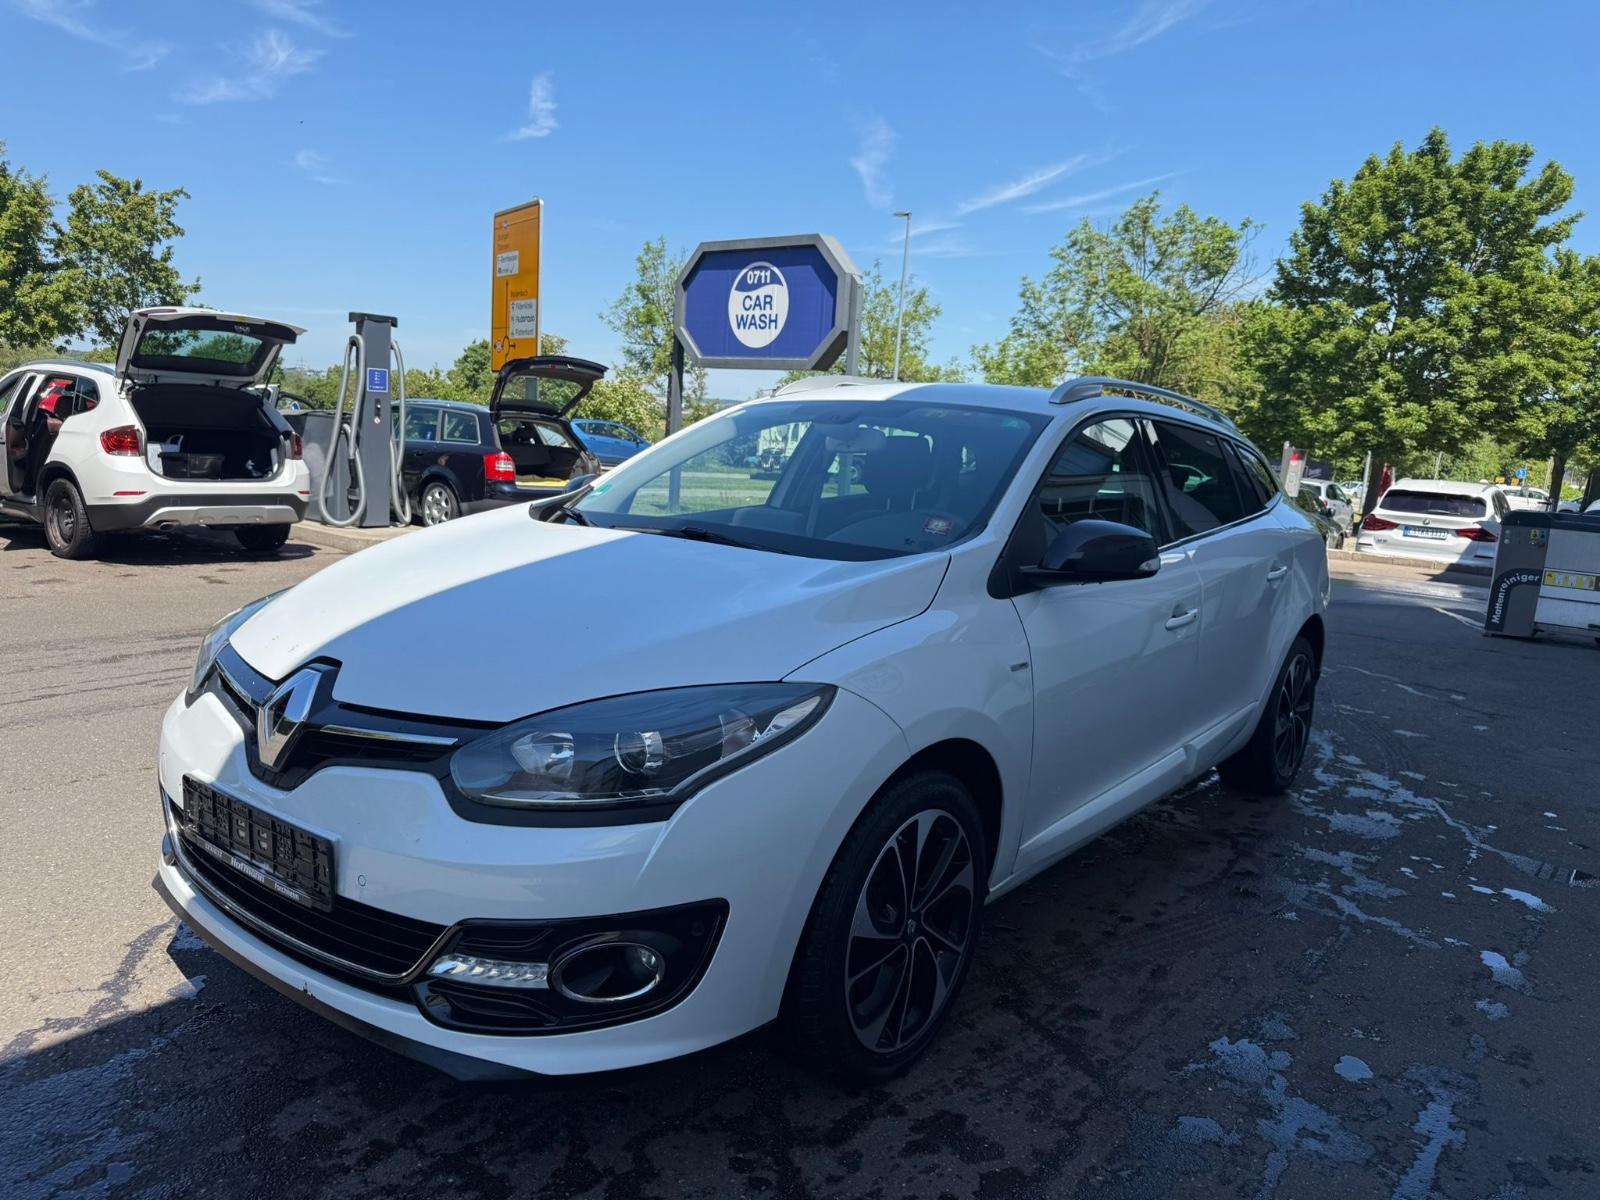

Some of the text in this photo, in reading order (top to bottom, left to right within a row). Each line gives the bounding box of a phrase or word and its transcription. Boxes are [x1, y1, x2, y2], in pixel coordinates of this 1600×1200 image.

[746, 270, 771, 285] 0711
[742, 294, 773, 312] CAR
[735, 313, 779, 331] WASH
[1490, 572, 1540, 624] Mattenreiniger
